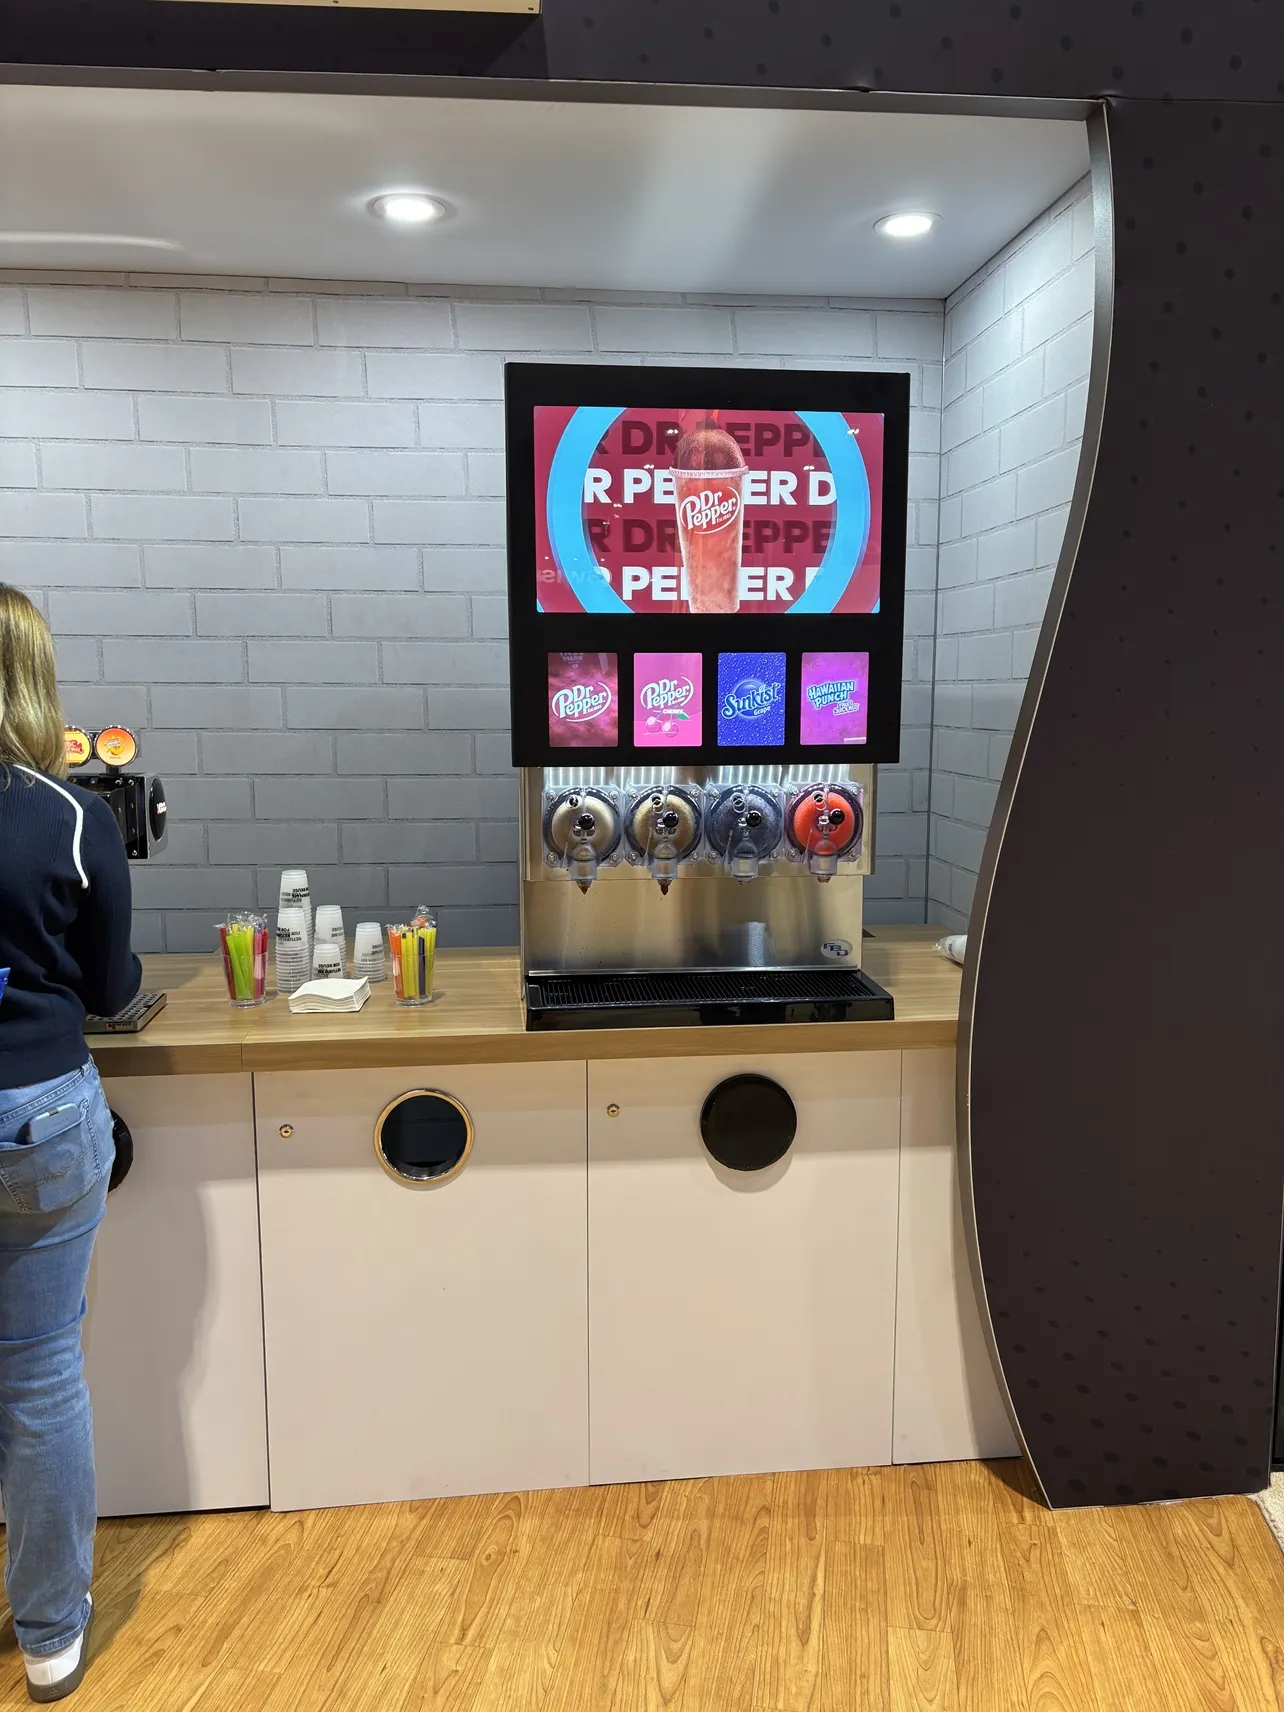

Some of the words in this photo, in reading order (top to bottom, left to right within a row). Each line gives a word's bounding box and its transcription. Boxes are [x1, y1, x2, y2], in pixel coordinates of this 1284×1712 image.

[728, 422, 826, 457] EPP
[680, 495, 737, 530] Pepper
[700, 490, 722, 511] Dr
[572, 685, 594, 702] Dr
[640, 682, 690, 709] Pepper
[658, 679, 678, 694] Dr
[807, 680, 856, 701] HAWAIIAN
[552, 689, 607, 718] Pepper
[721, 682, 781, 719] Sunkist
[813, 690, 850, 709] PUNCH
